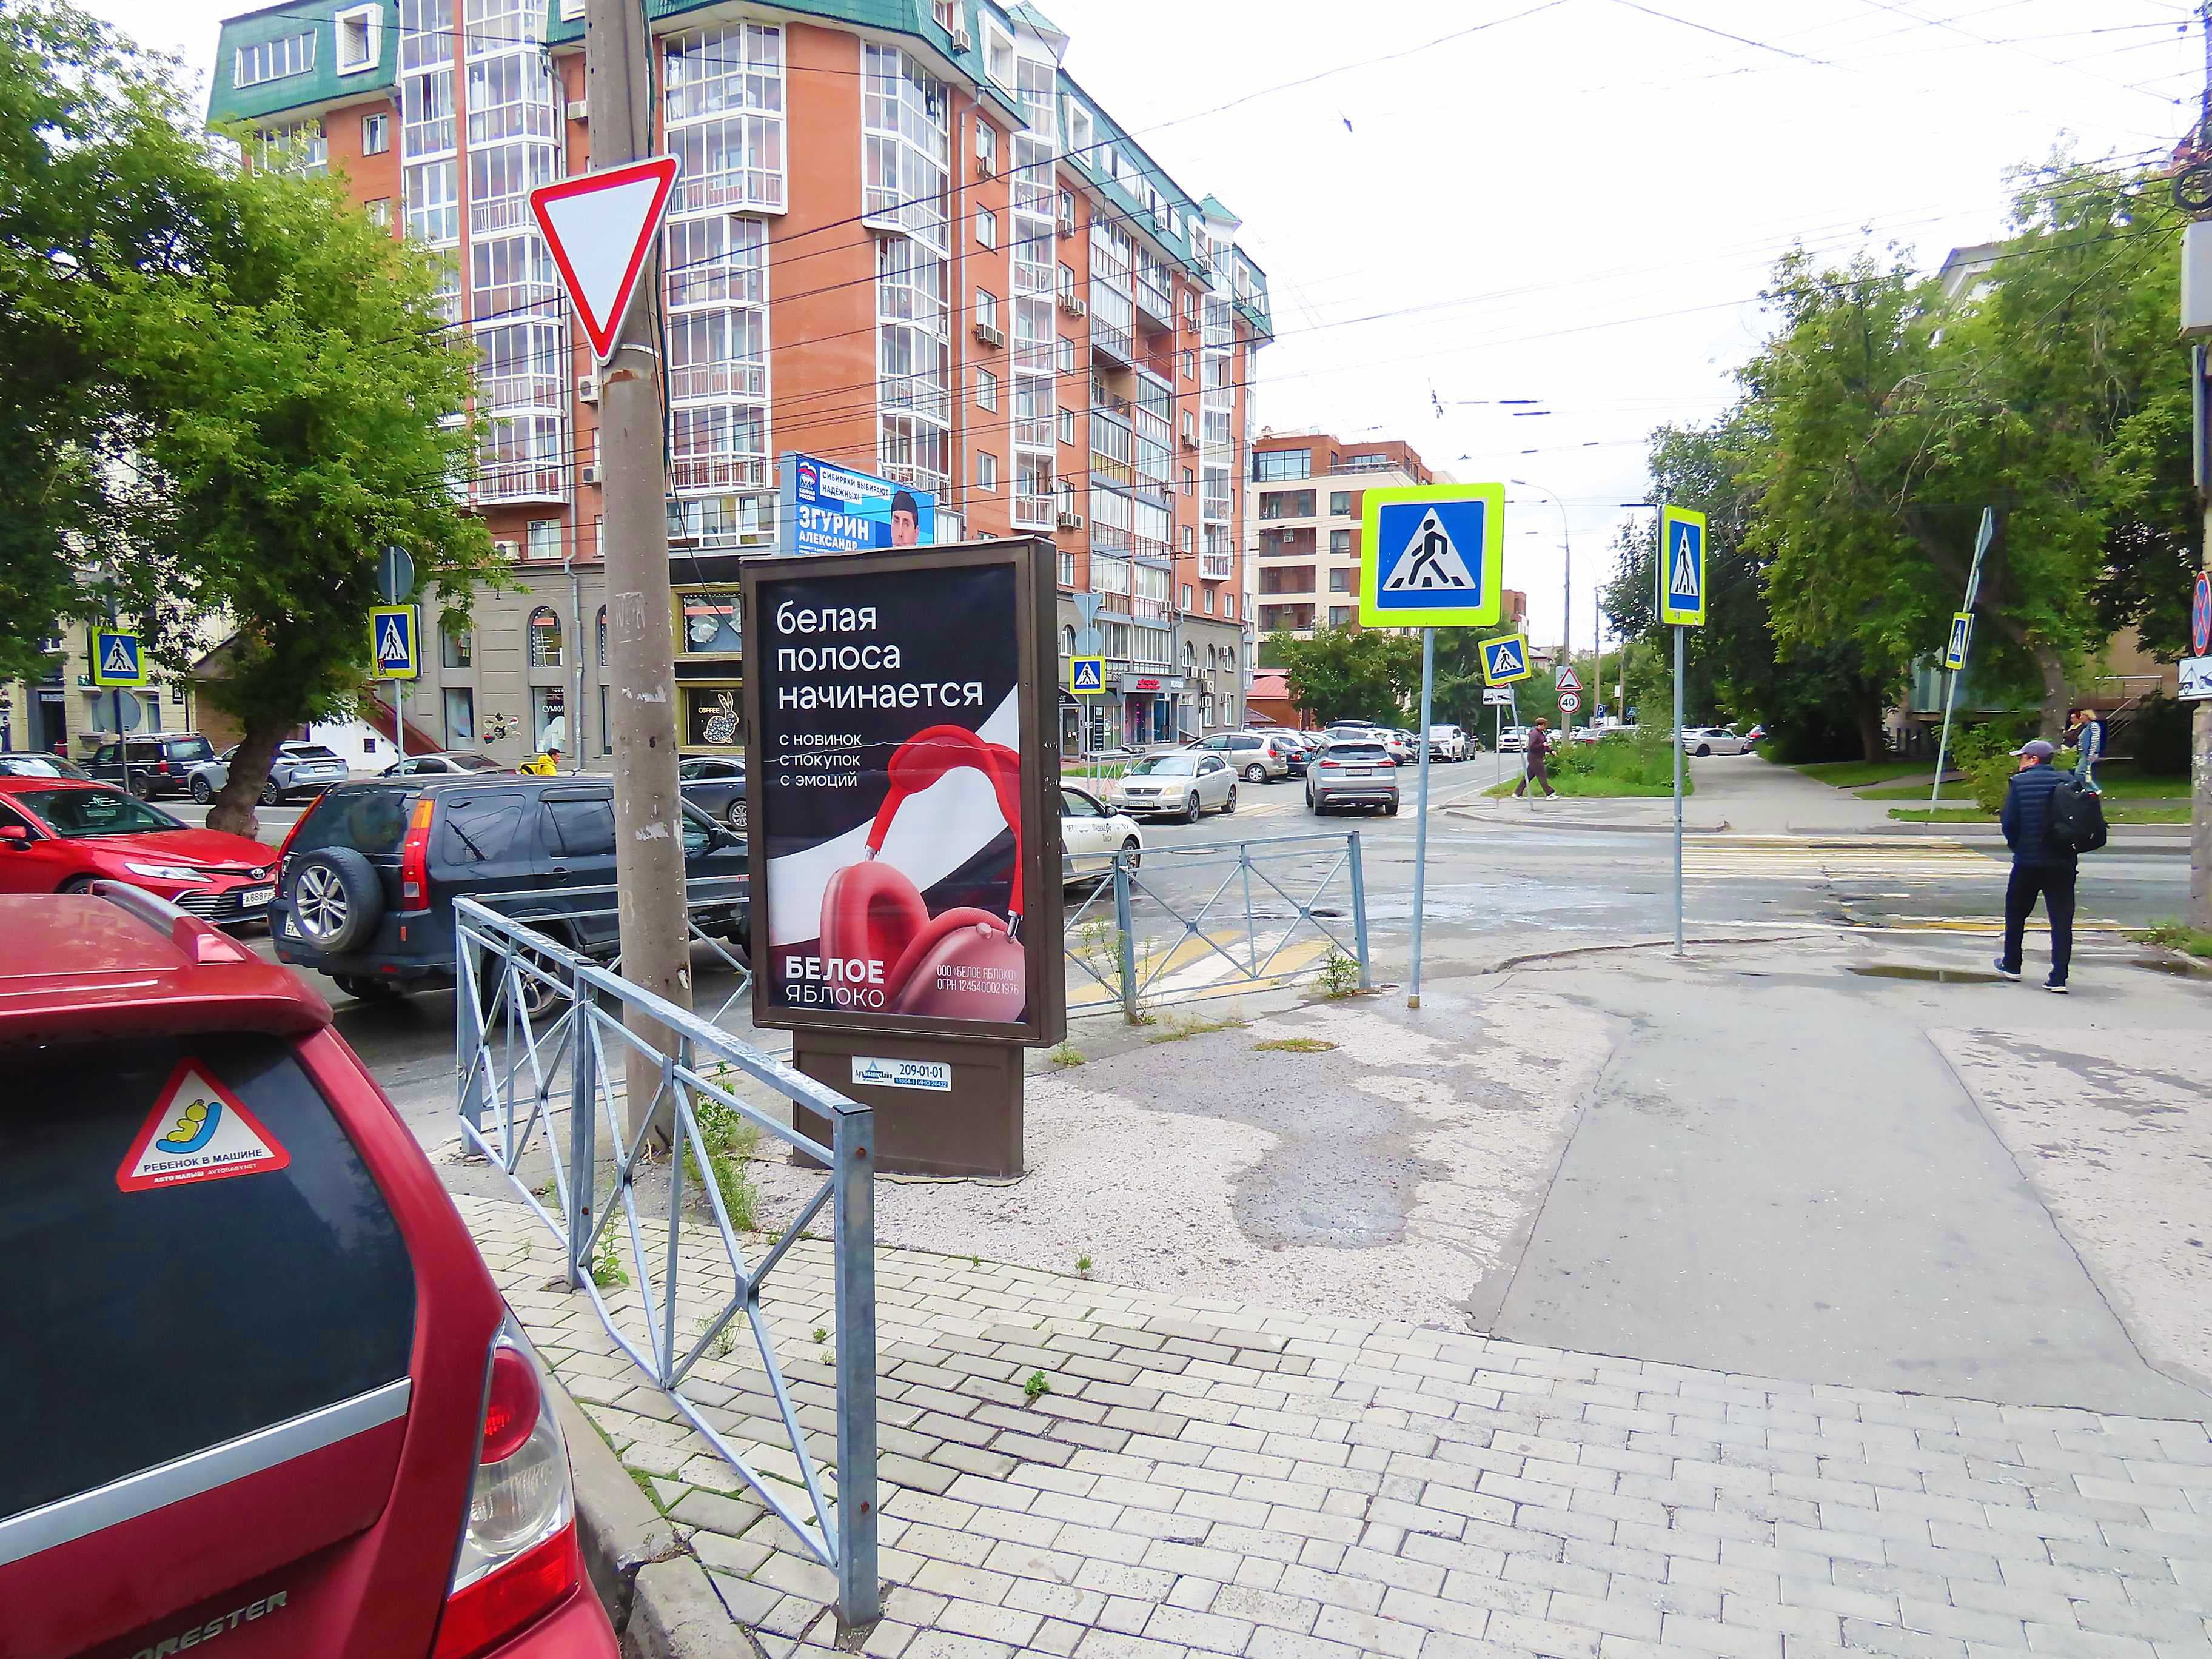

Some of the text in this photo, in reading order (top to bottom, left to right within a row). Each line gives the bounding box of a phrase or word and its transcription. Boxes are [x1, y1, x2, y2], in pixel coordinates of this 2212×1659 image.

[822, 471, 888, 496] СИБИРЯКИ ВЫБИРАЮТ
[799, 505, 869, 541] ЗГУРИН
[799, 530, 857, 552] АЛЕКСАНДР
[776, 600, 877, 634] белая
[777, 645, 901, 672] полоса
[778, 681, 984, 709] начинается
[1562, 698, 1575, 706] 40
[779, 734, 862, 746] с новинок
[779, 754, 861, 770] с покупок
[780, 771, 858, 789] с эмоций
[785, 956, 885, 984] БЕЛОЕ
[937, 965, 952, 976] ООО
[953, 966, 981, 979] «БЕЛОЕ
[786, 984, 885, 1008] ЯБЛОКО
[937, 979, 1019, 995] ОГРН 1245400021976
[899, 1064, 942, 1078] 209-01-01
[144, 1158, 199, 1173] РЕБЕНОК
[213, 1149, 263, 1163] МАШИНЕ
